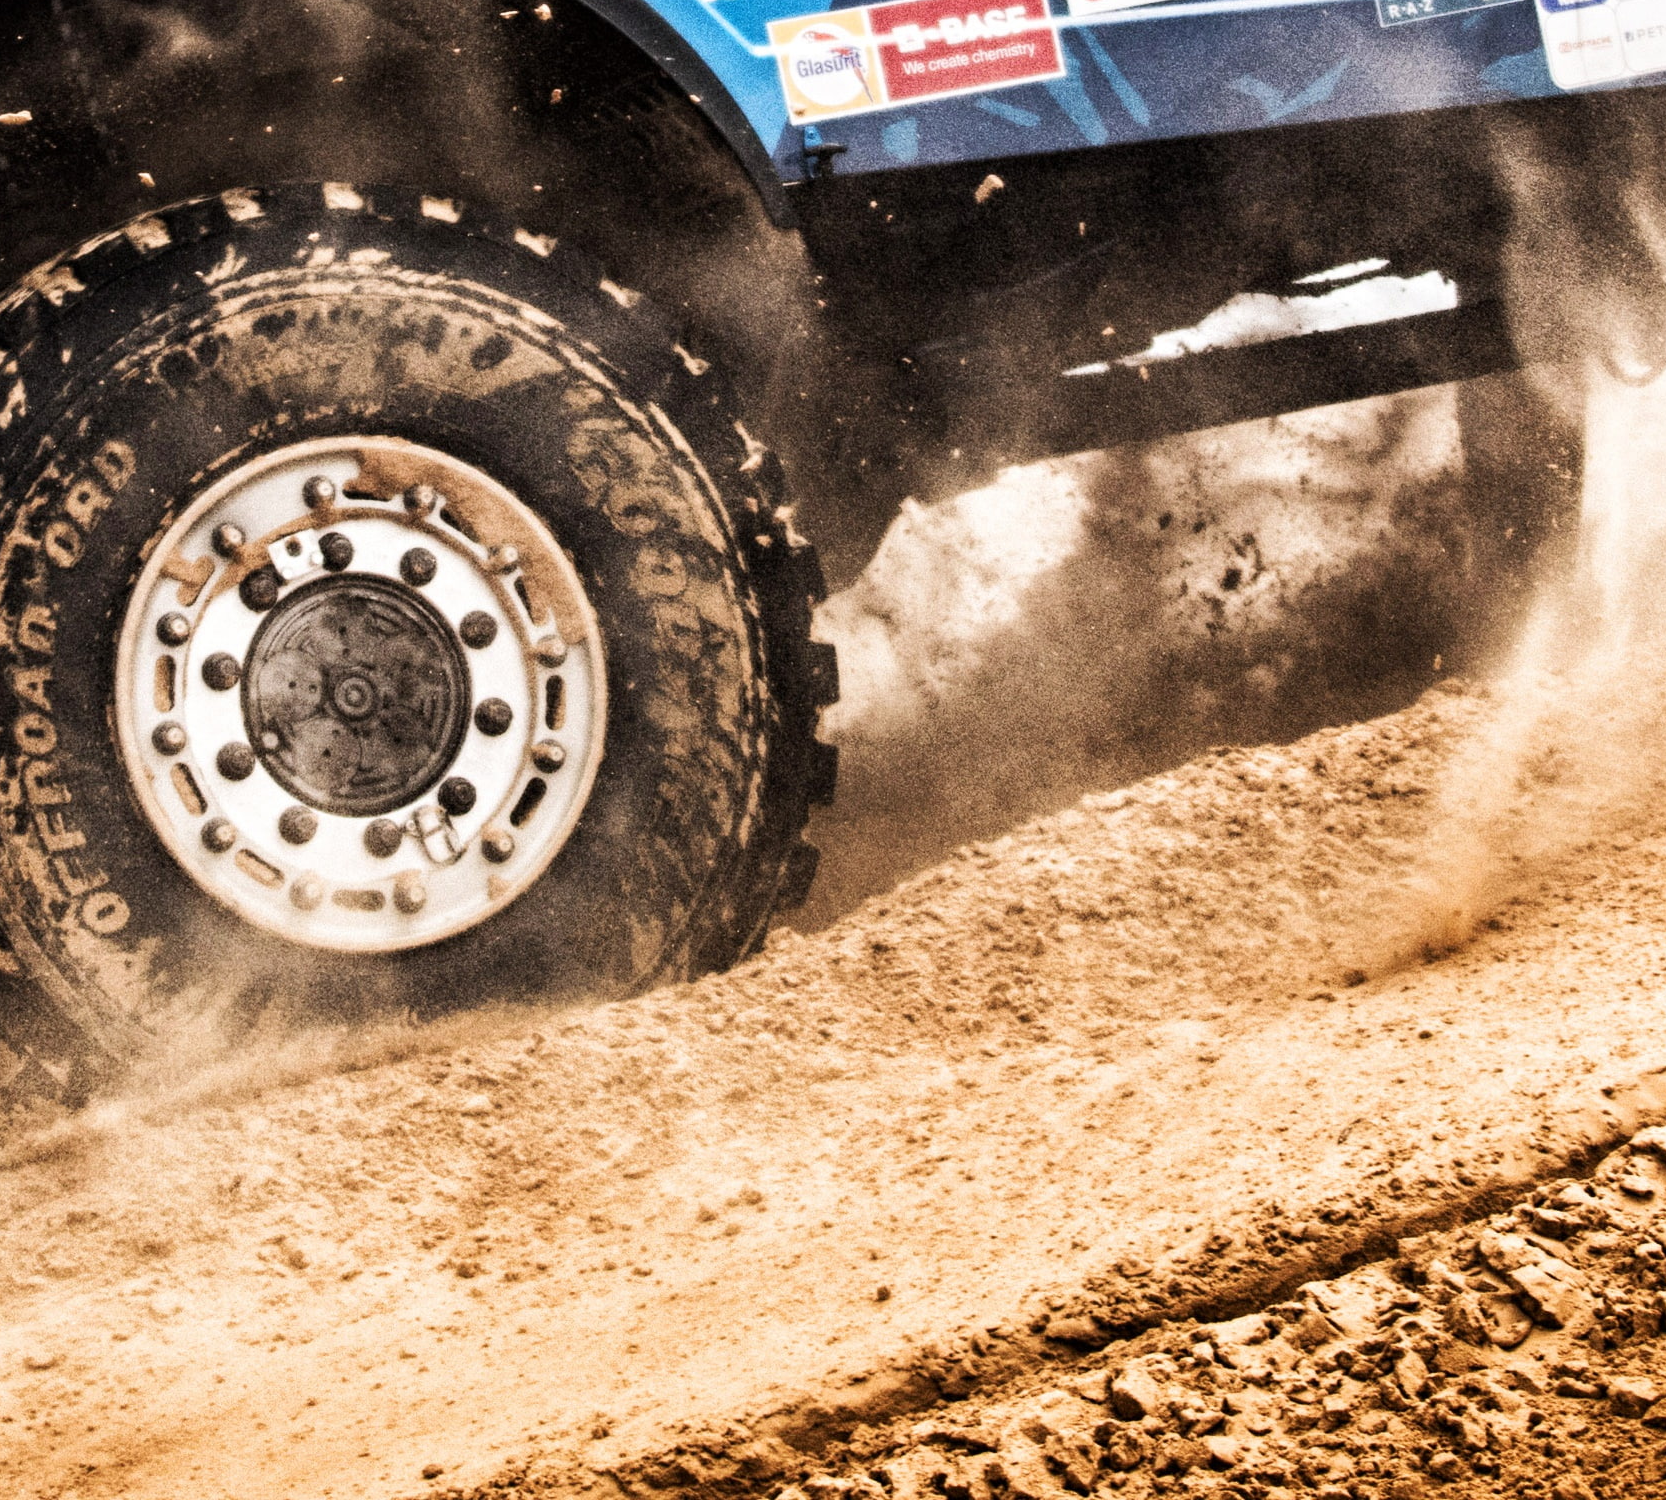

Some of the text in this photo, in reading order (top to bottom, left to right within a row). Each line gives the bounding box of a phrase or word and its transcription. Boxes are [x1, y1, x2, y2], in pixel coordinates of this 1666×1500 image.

[902, 41, 1036, 77] We create chemistry
